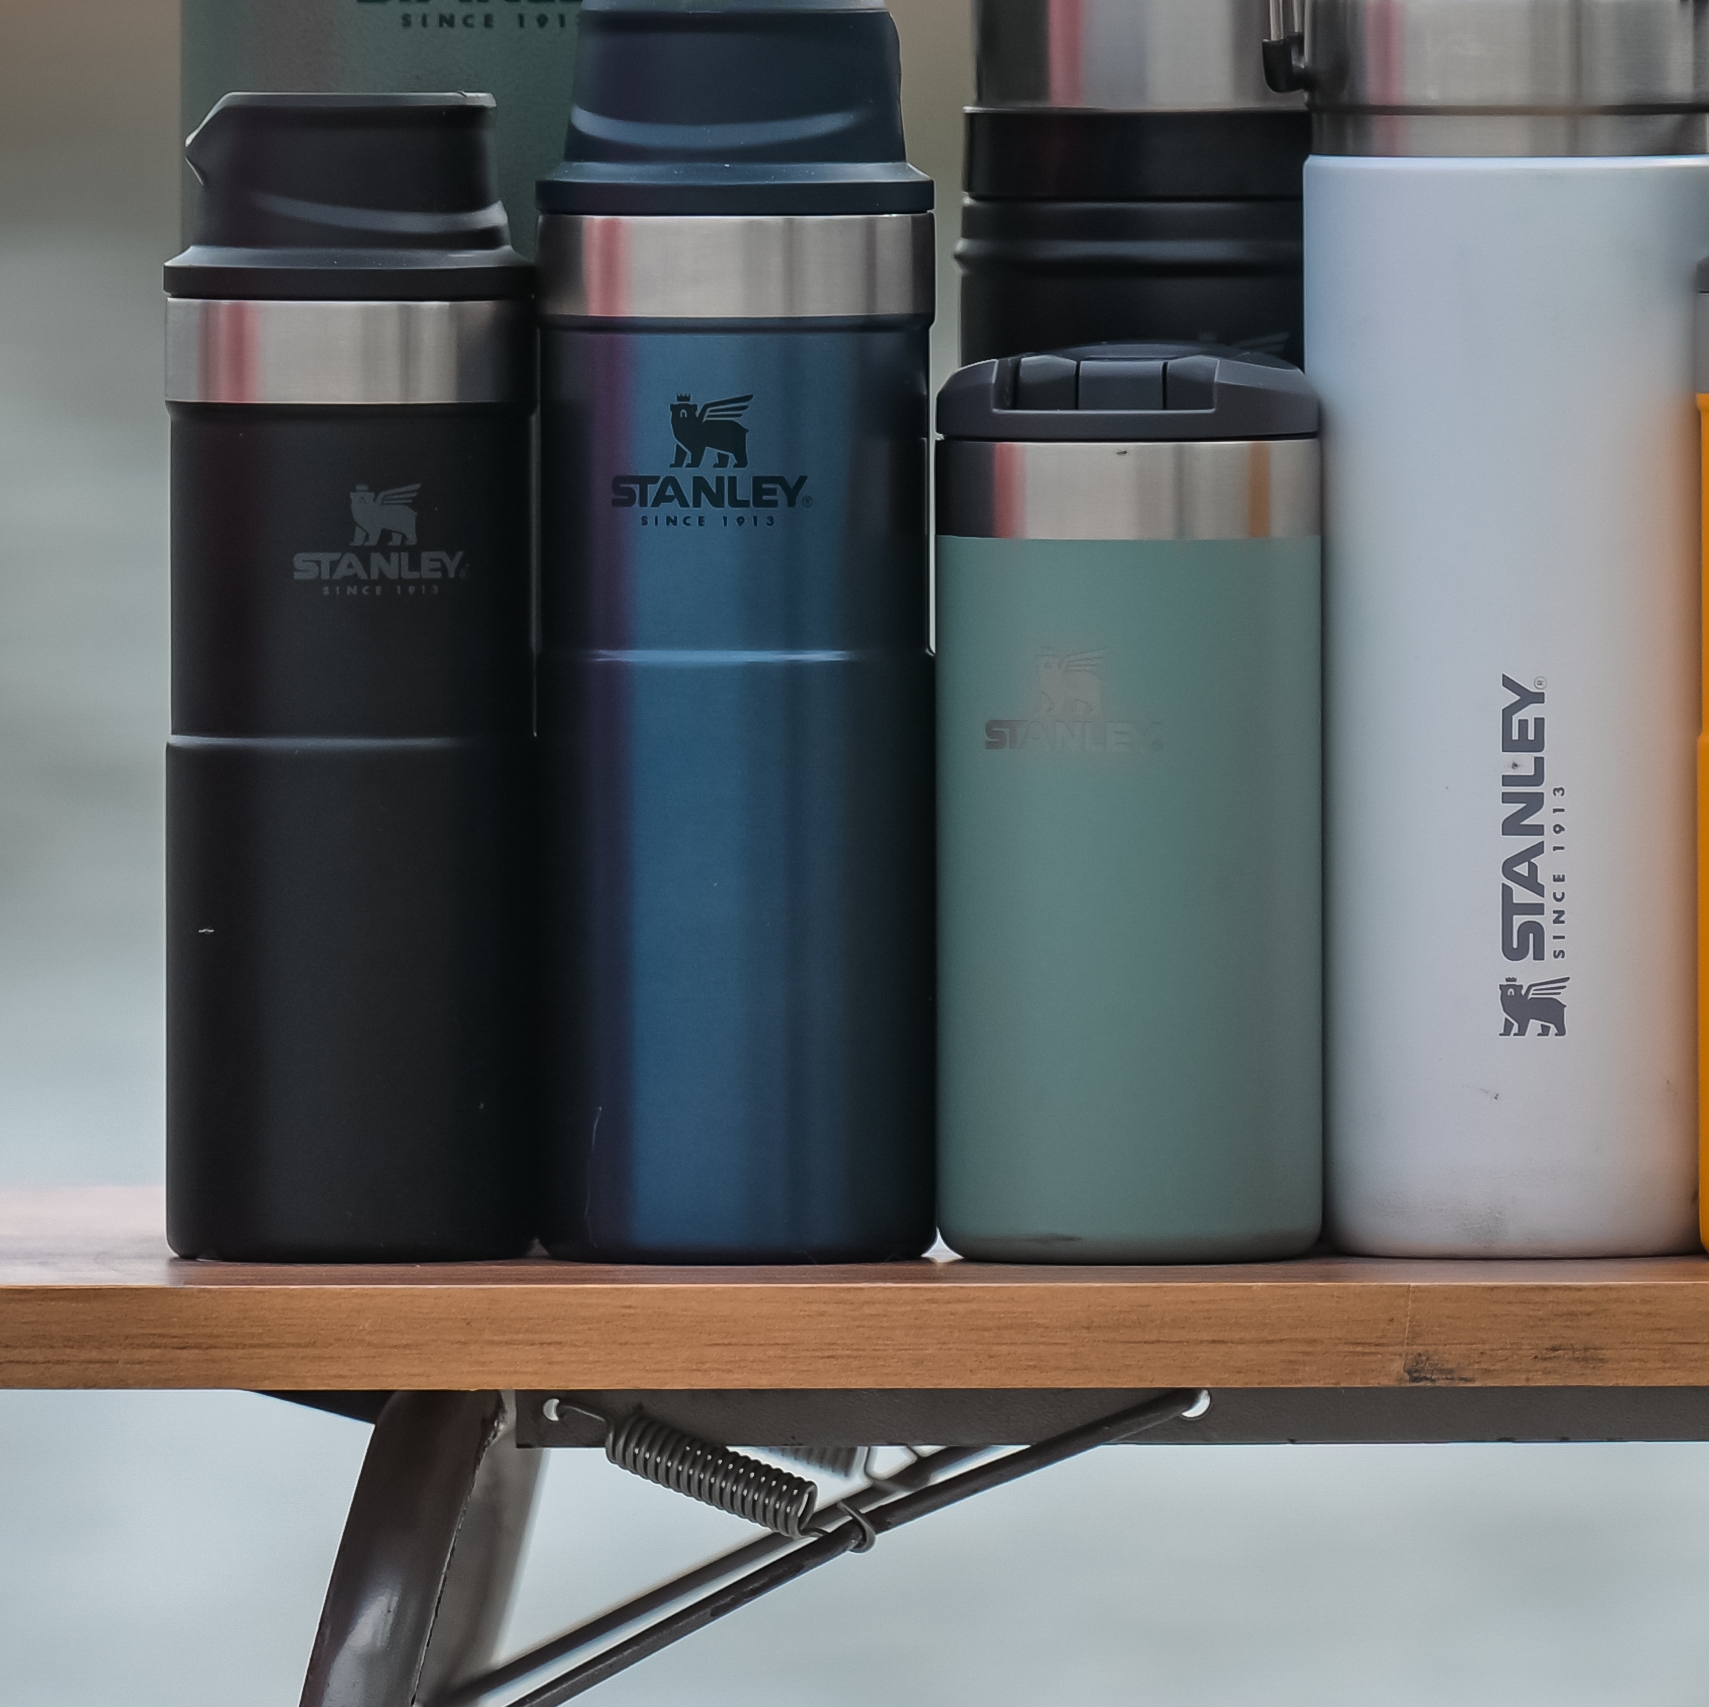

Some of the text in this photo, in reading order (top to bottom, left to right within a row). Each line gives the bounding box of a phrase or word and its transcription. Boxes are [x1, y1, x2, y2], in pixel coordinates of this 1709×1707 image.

[401, 13, 580, 28] SINCE 191
[611, 475, 809, 508] STANLEY
[641, 515, 775, 527] SINCE 1913
[293, 551, 464, 580] STANLEY
[323, 584, 439, 595] SINCE 1913
[1501, 672, 1546, 962] STANLEY
[1552, 786, 1566, 960] SINCE 1913
